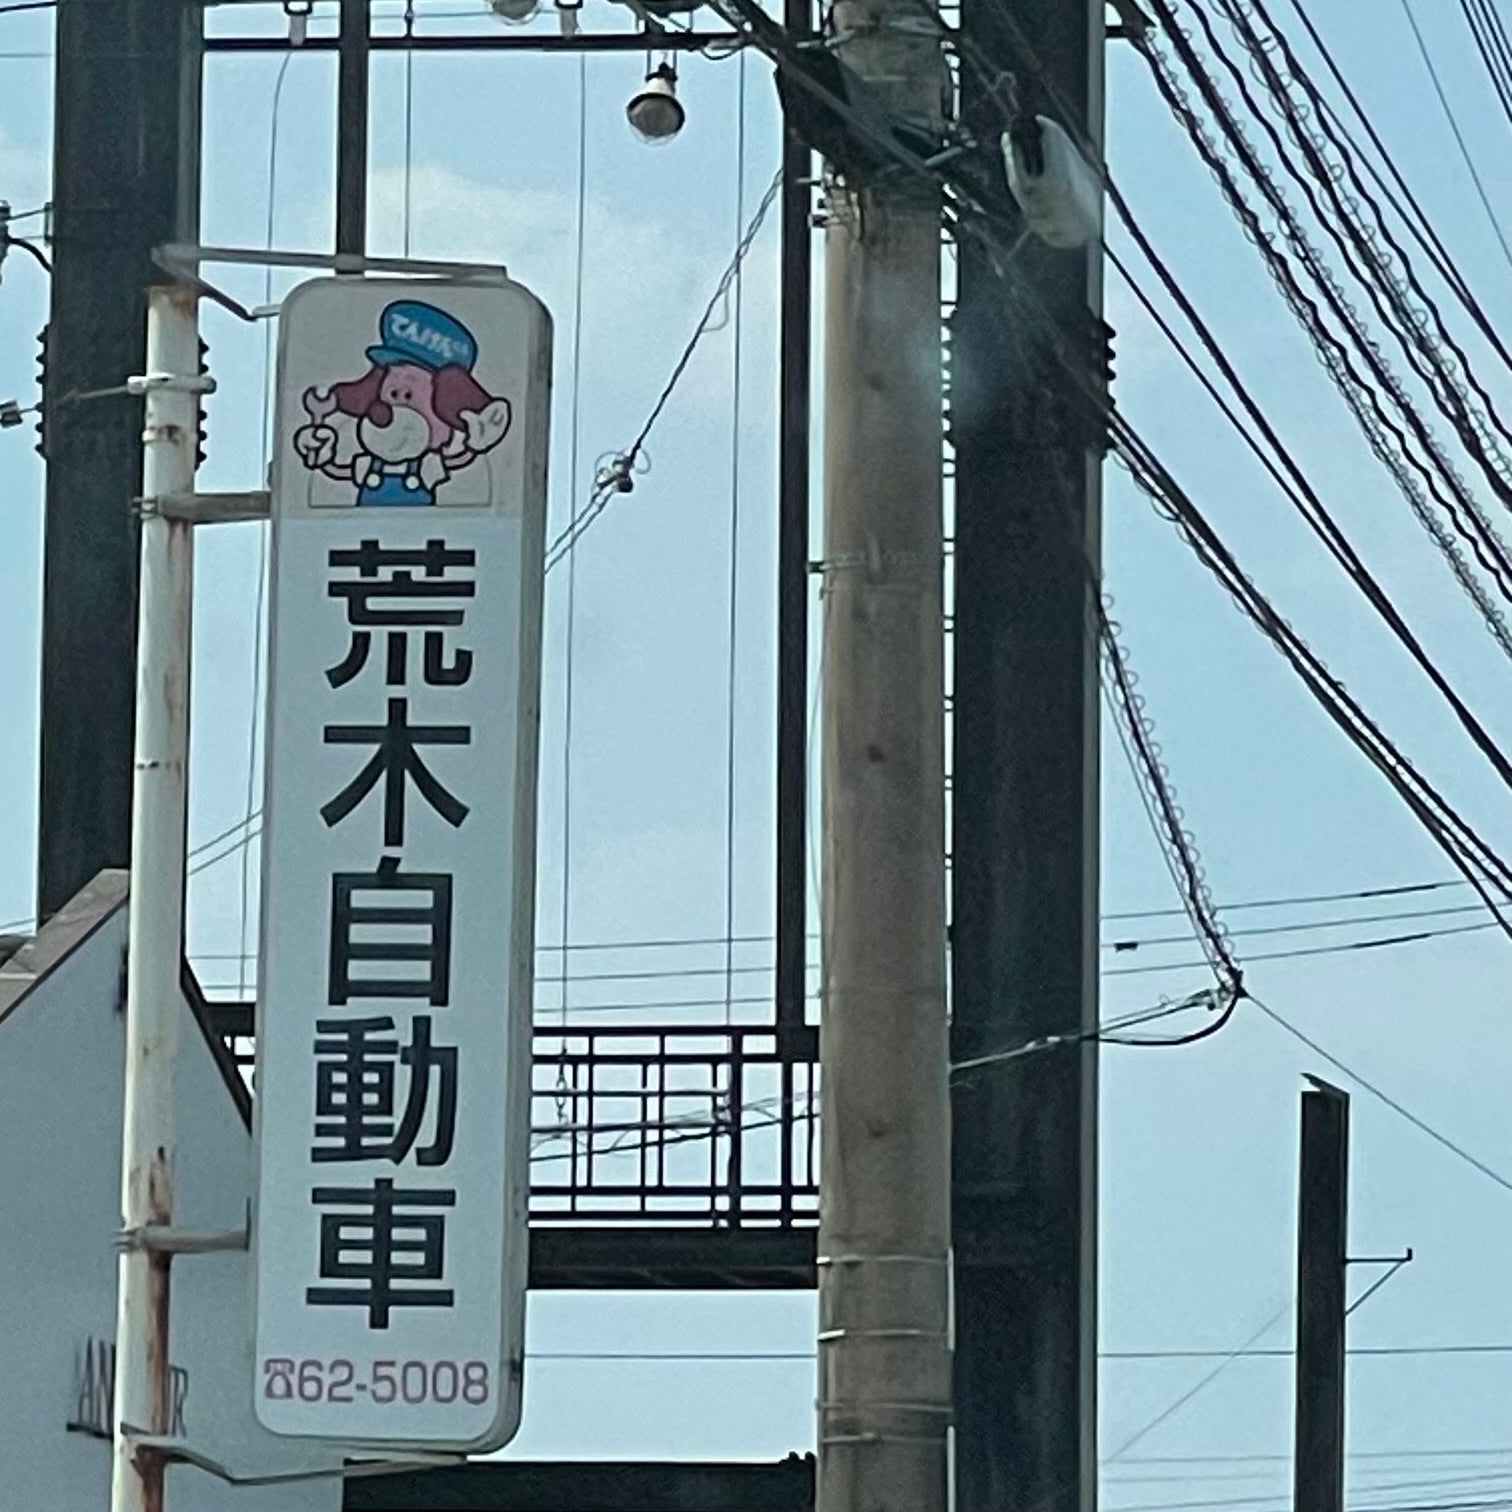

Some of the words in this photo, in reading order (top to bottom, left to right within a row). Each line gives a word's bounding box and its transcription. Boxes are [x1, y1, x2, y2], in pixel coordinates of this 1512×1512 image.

[305, 539, 477, 1329] 荒木自動車
